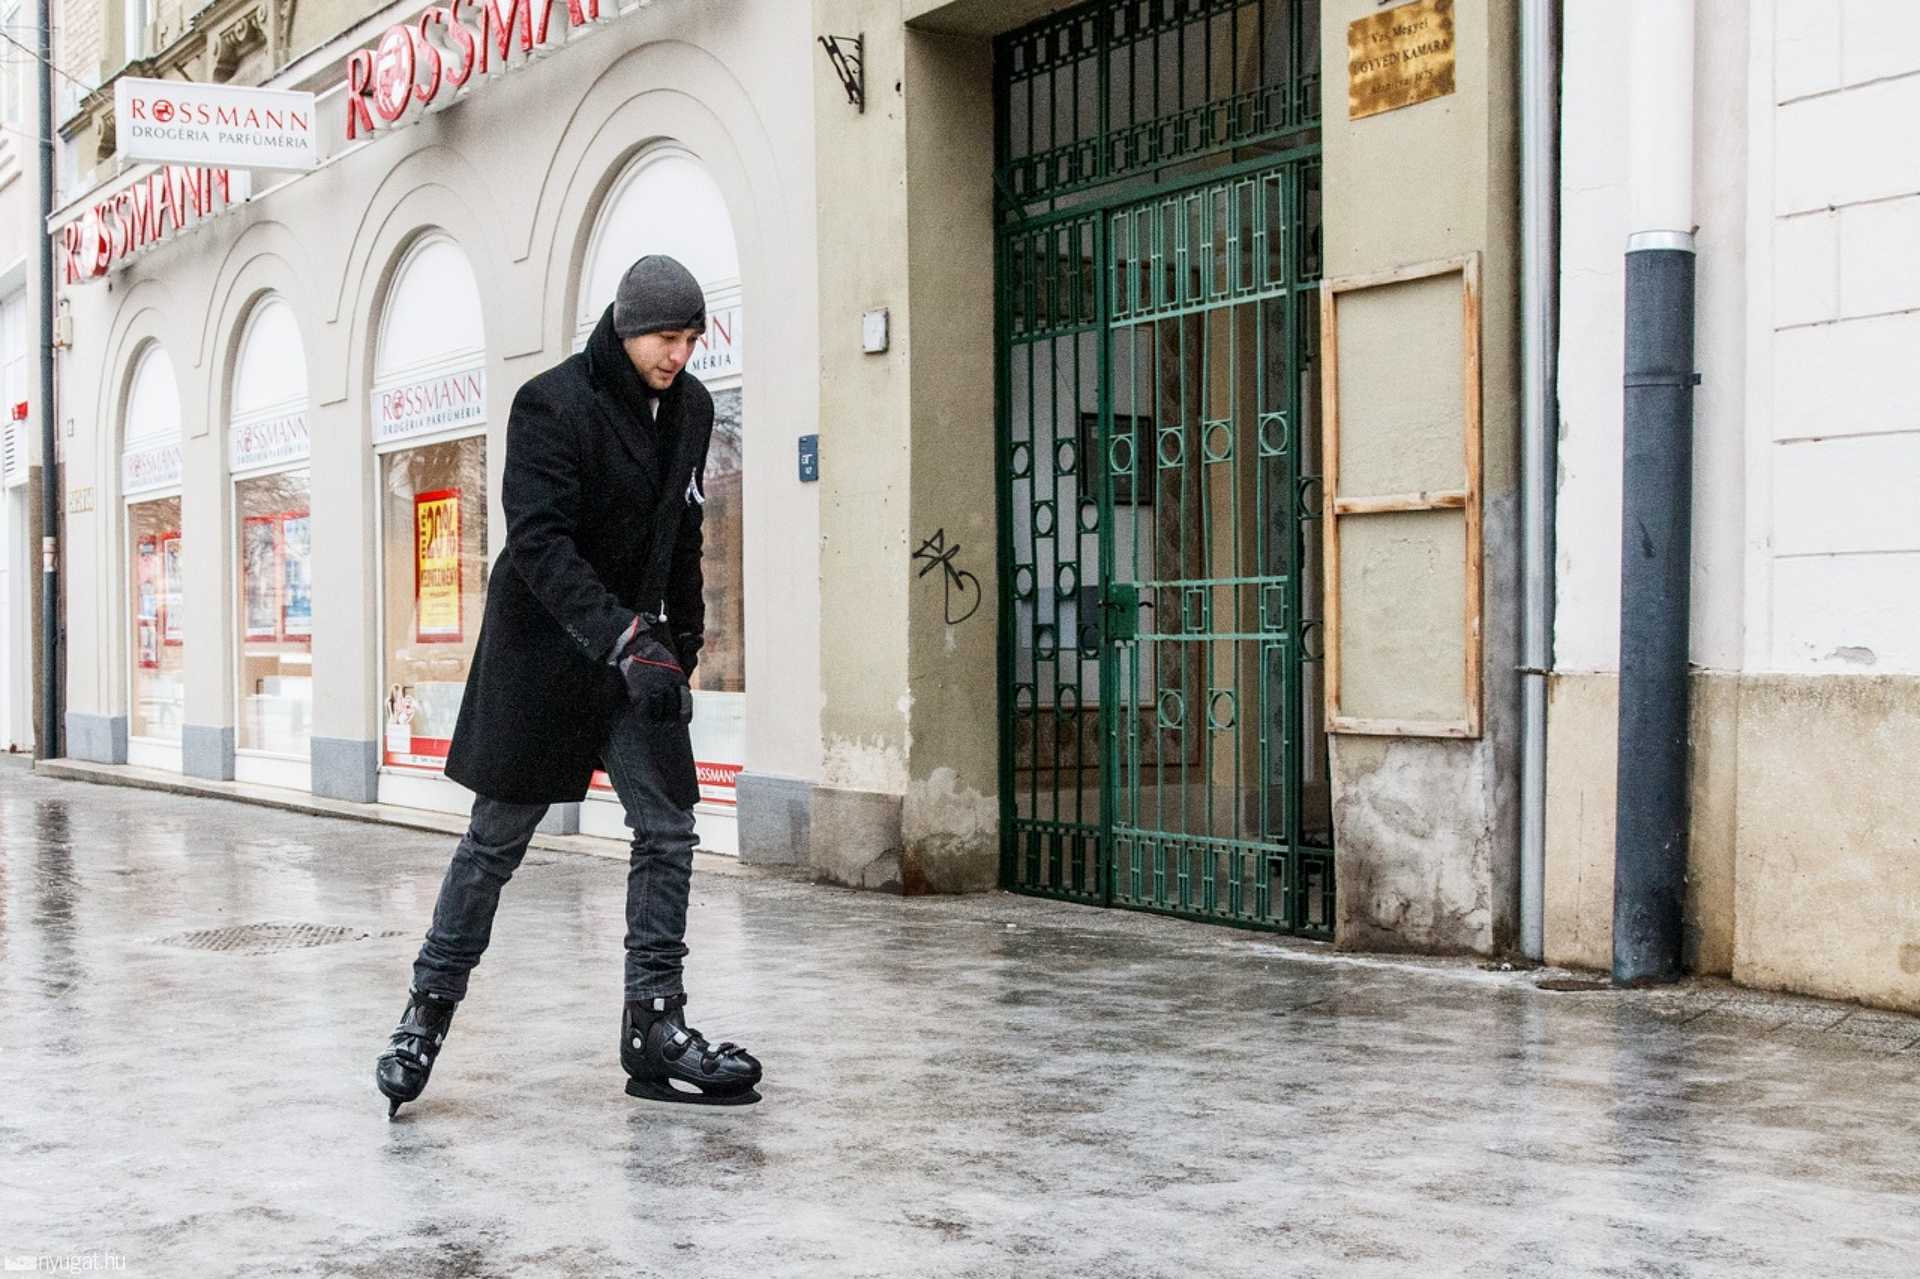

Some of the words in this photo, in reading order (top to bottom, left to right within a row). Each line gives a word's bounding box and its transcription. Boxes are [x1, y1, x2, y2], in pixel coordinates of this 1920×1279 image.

[1402, 39, 1451, 62] KAMARA
[131, 98, 309, 132] ROSSMANN
[132, 124, 210, 142] DROGÉRIA
[218, 131, 309, 149] PARFÜMÉRIA
[63, 165, 230, 285] ROSSMANN
[383, 371, 481, 421] ROSSMANN
